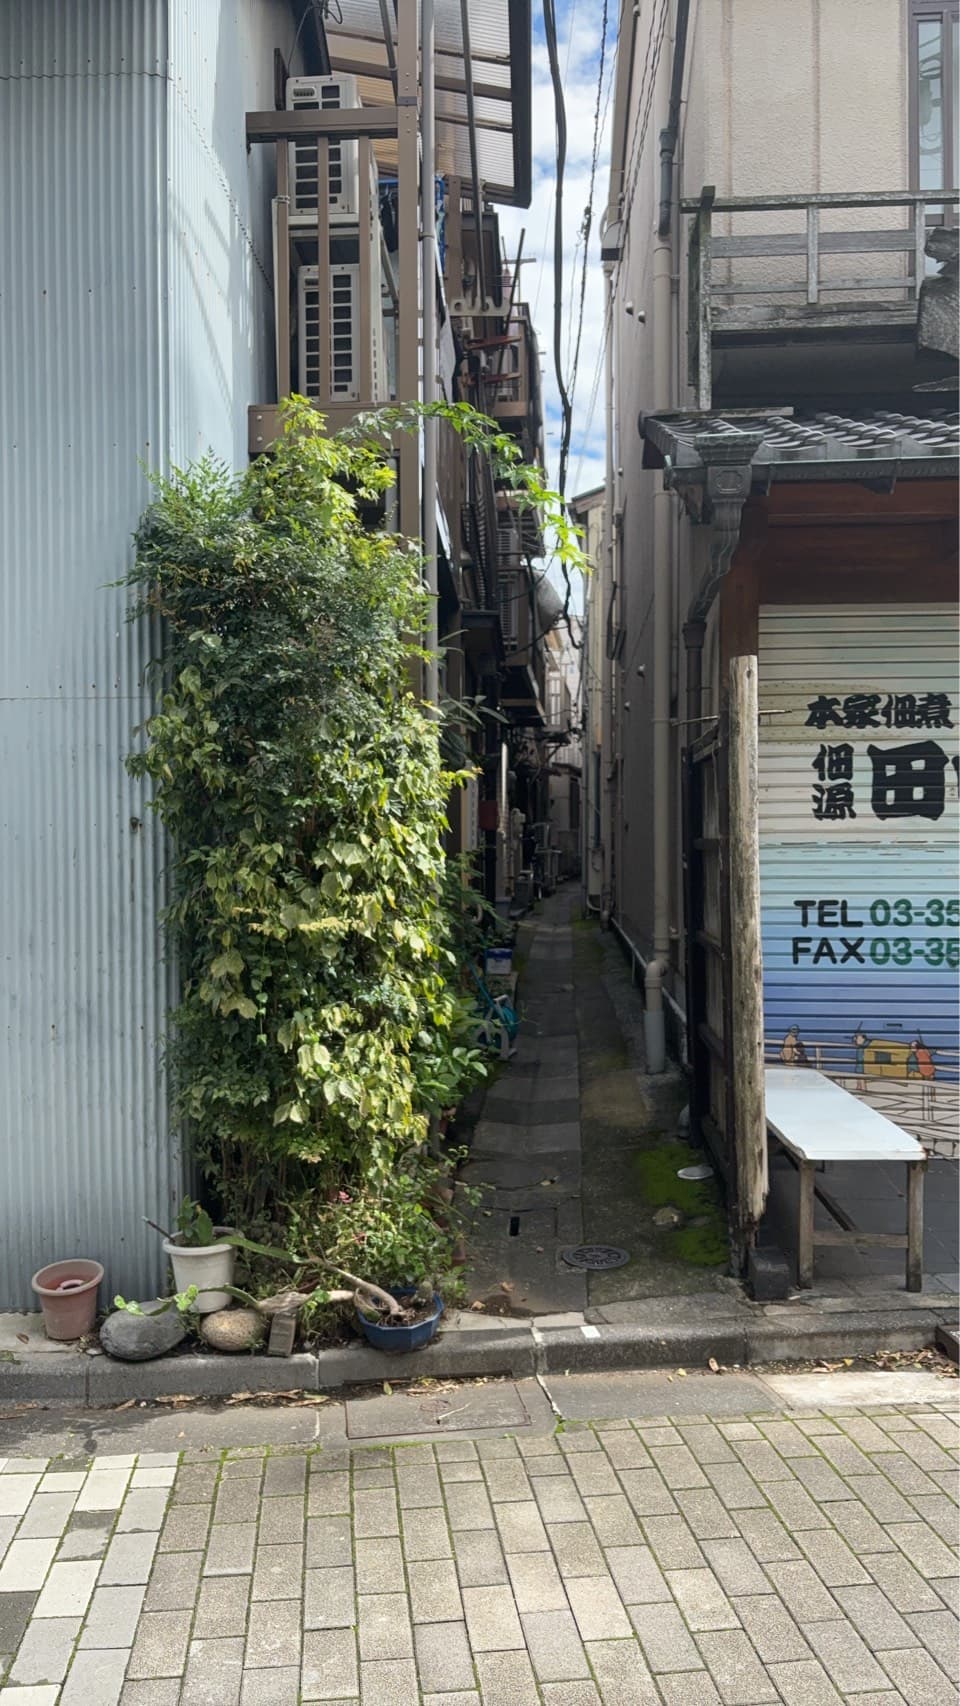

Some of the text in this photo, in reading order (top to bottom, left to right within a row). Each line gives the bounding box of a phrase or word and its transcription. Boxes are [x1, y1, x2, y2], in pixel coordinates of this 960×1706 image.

[805, 693, 954, 729] 本家佃煮
[812, 743, 856, 820] 佃源
[867, 740, 959, 821] 田
[794, 899, 959, 927] TEL 03-35
[792, 937, 866, 965] FAX
